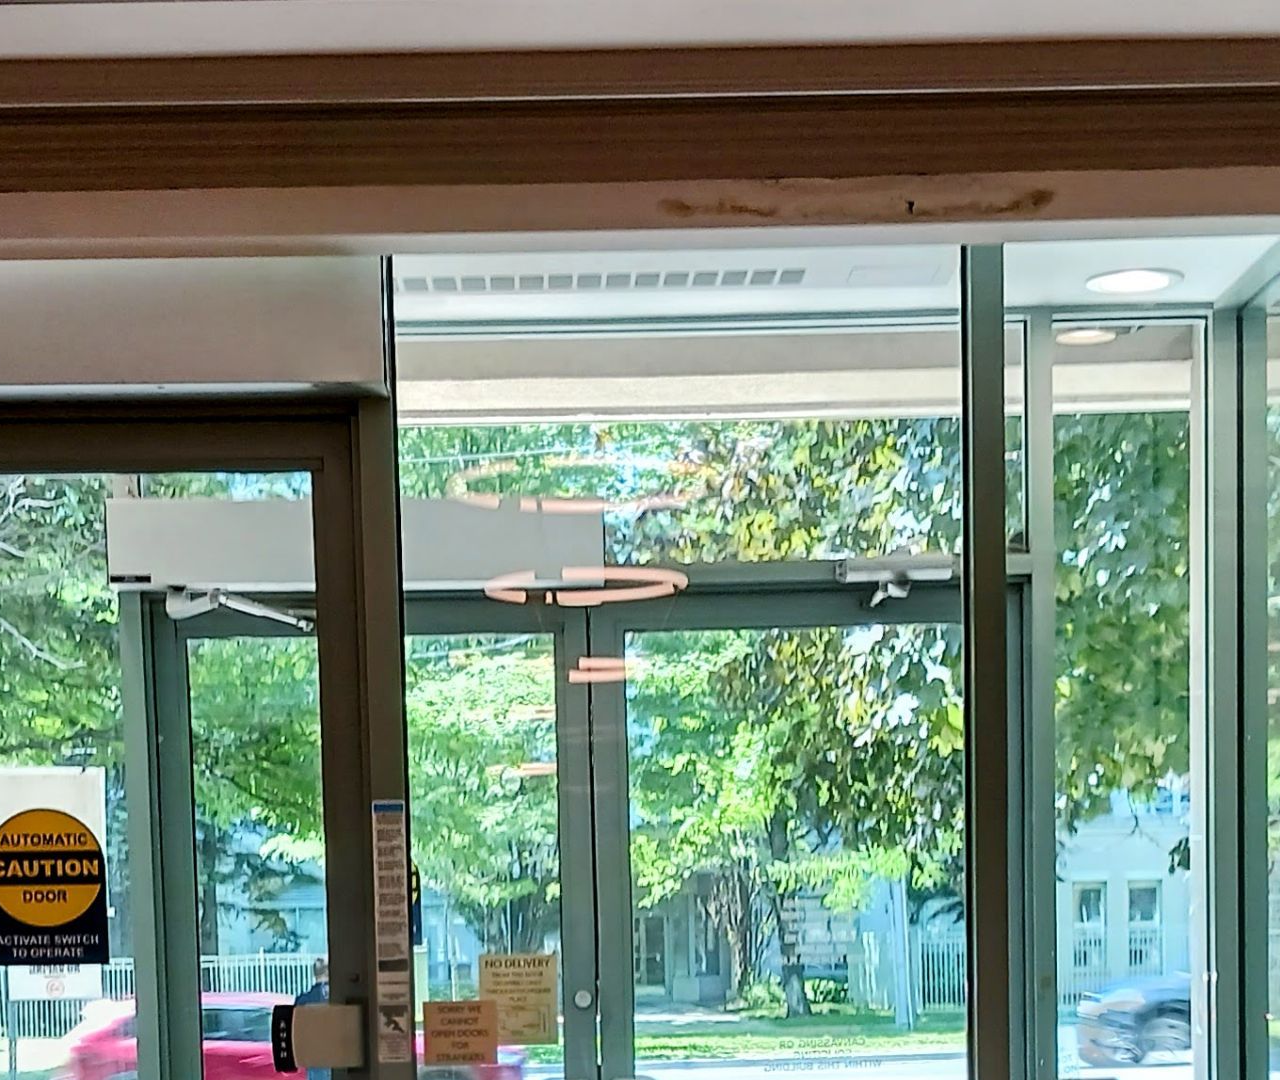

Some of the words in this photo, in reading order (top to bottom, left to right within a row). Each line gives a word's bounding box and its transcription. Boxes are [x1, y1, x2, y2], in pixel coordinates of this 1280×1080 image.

[0, 833, 88, 847] AUTOMATIC
[22, 889, 68, 904] DOOR
[54, 934, 100, 946] SWITCH
[12, 947, 28, 959] TO
[30, 946, 85, 958] OPERATE
[484, 959, 503, 969] NO
[504, 958, 551, 969] DELIVERY
[438, 1005, 465, 1014] SORRY
[467, 1004, 481, 1014] WE
[440, 1017, 479, 1026] CANNOT
[431, 1030, 455, 1038] OPEN
[457, 1029, 490, 1038] DOORS
[451, 1041, 469, 1050] FOR
